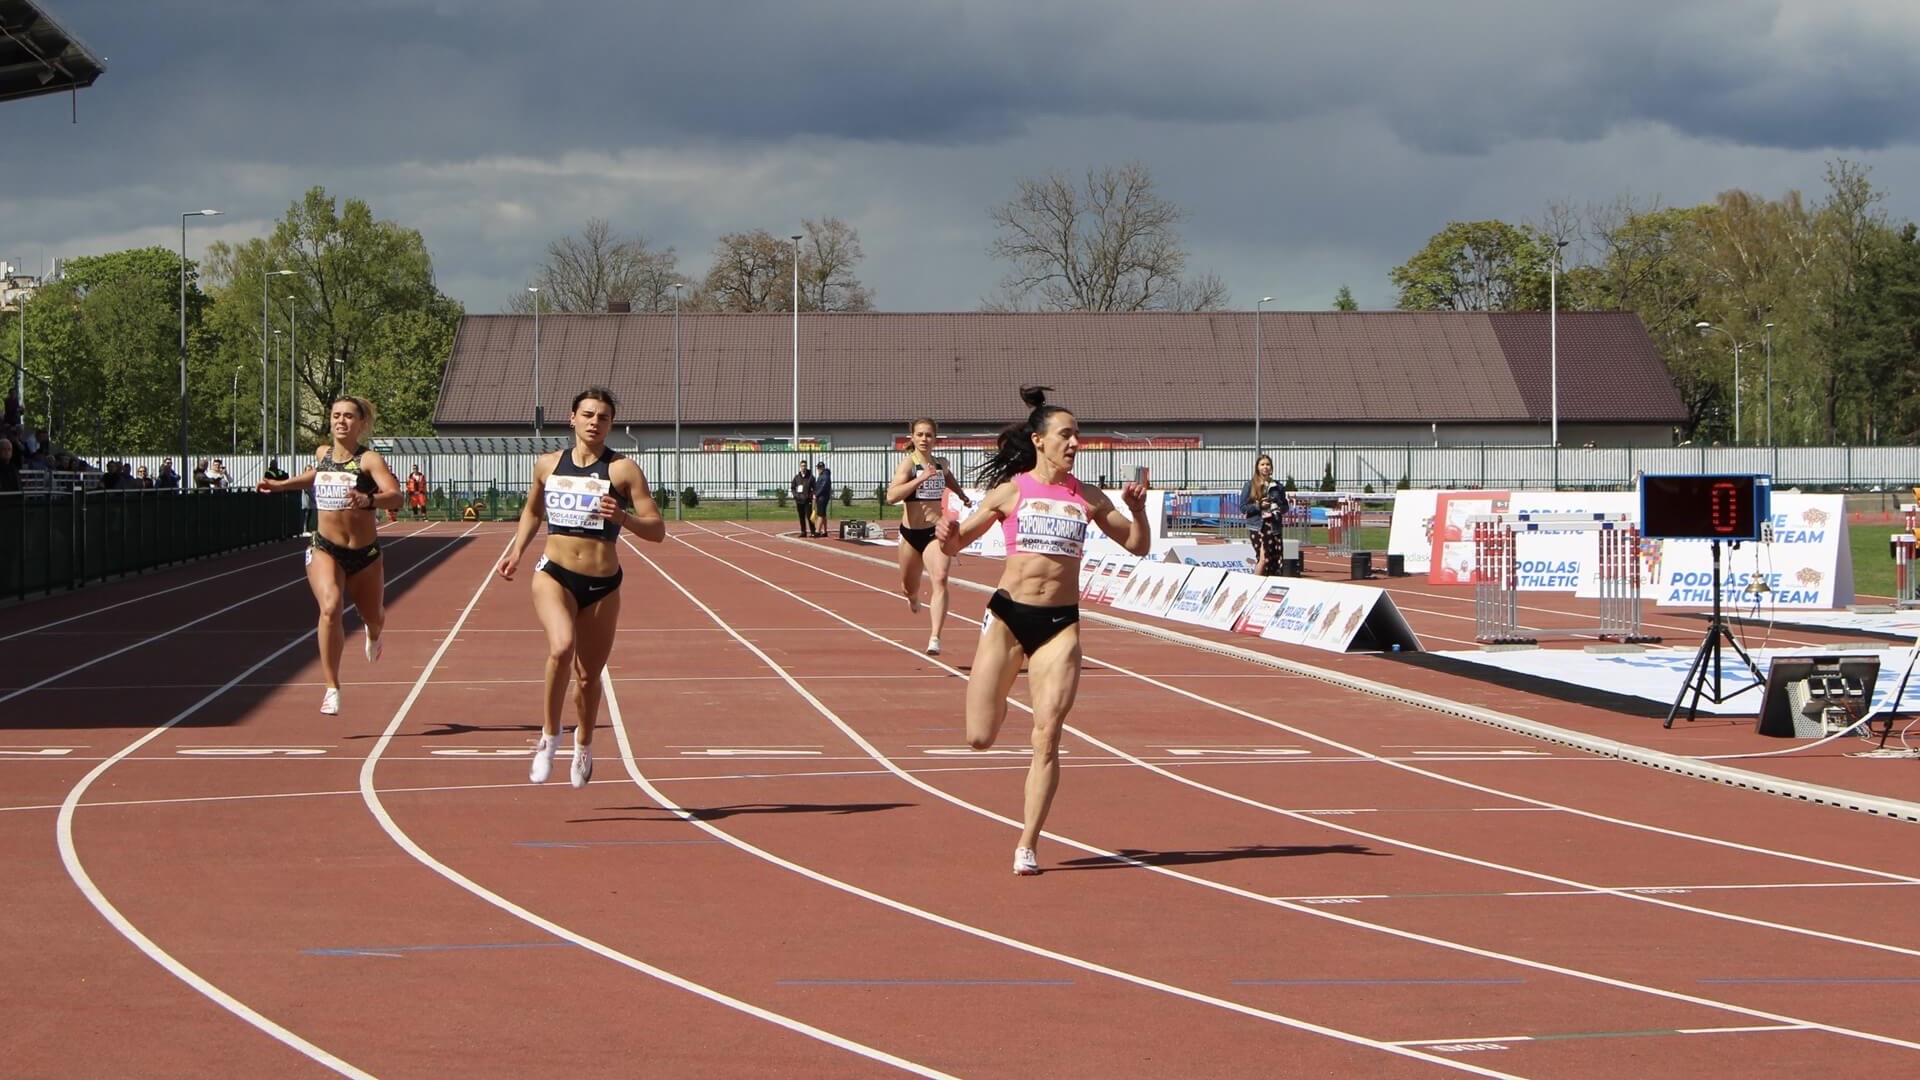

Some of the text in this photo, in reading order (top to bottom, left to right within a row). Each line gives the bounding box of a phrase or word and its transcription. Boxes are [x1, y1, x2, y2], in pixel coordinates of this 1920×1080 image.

[546, 492, 601, 513] GOLA
[1713, 483, 1737, 532] 0
[1776, 530, 1825, 543] TEAM
[1201, 560, 1244, 569] PODLASKIE
[1515, 561, 1580, 574] PODLAS
[1670, 572, 1782, 588] PODASIE
[1770, 589, 1819, 604] TEAM
